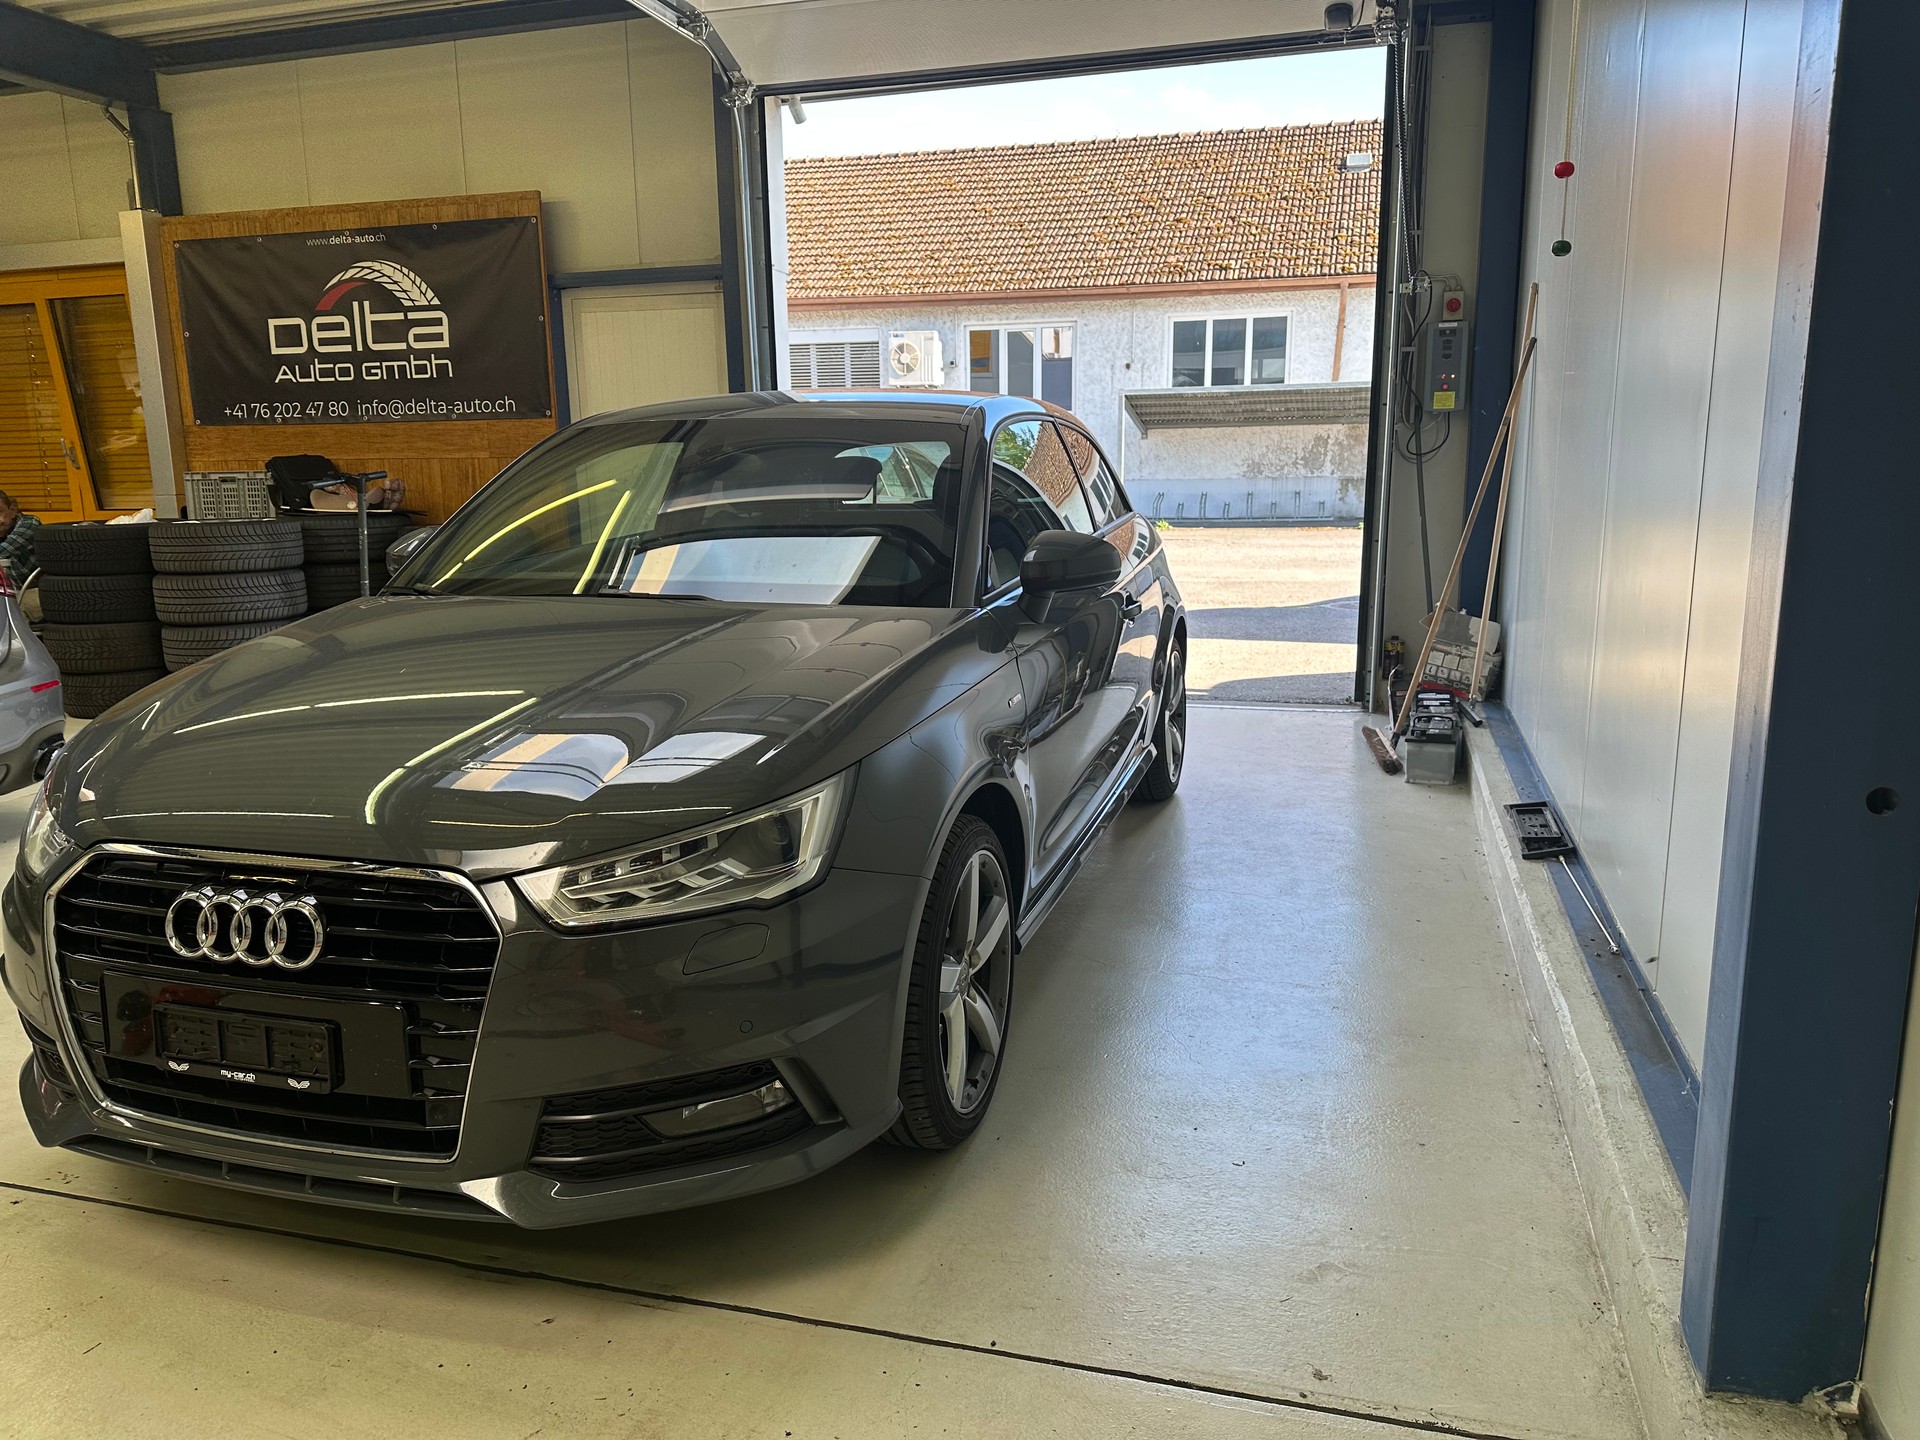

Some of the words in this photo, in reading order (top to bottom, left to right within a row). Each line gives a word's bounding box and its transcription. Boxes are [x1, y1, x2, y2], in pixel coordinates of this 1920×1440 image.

[306, 232, 387, 246] www.delta-auto.ch
[223, 403, 248, 419] +41
[250, 402, 271, 419] 76
[272, 402, 303, 418] 202
[305, 401, 324, 417] 47
[328, 400, 349, 417] 80
[357, 395, 516, 419] info@delta-auto.ch
